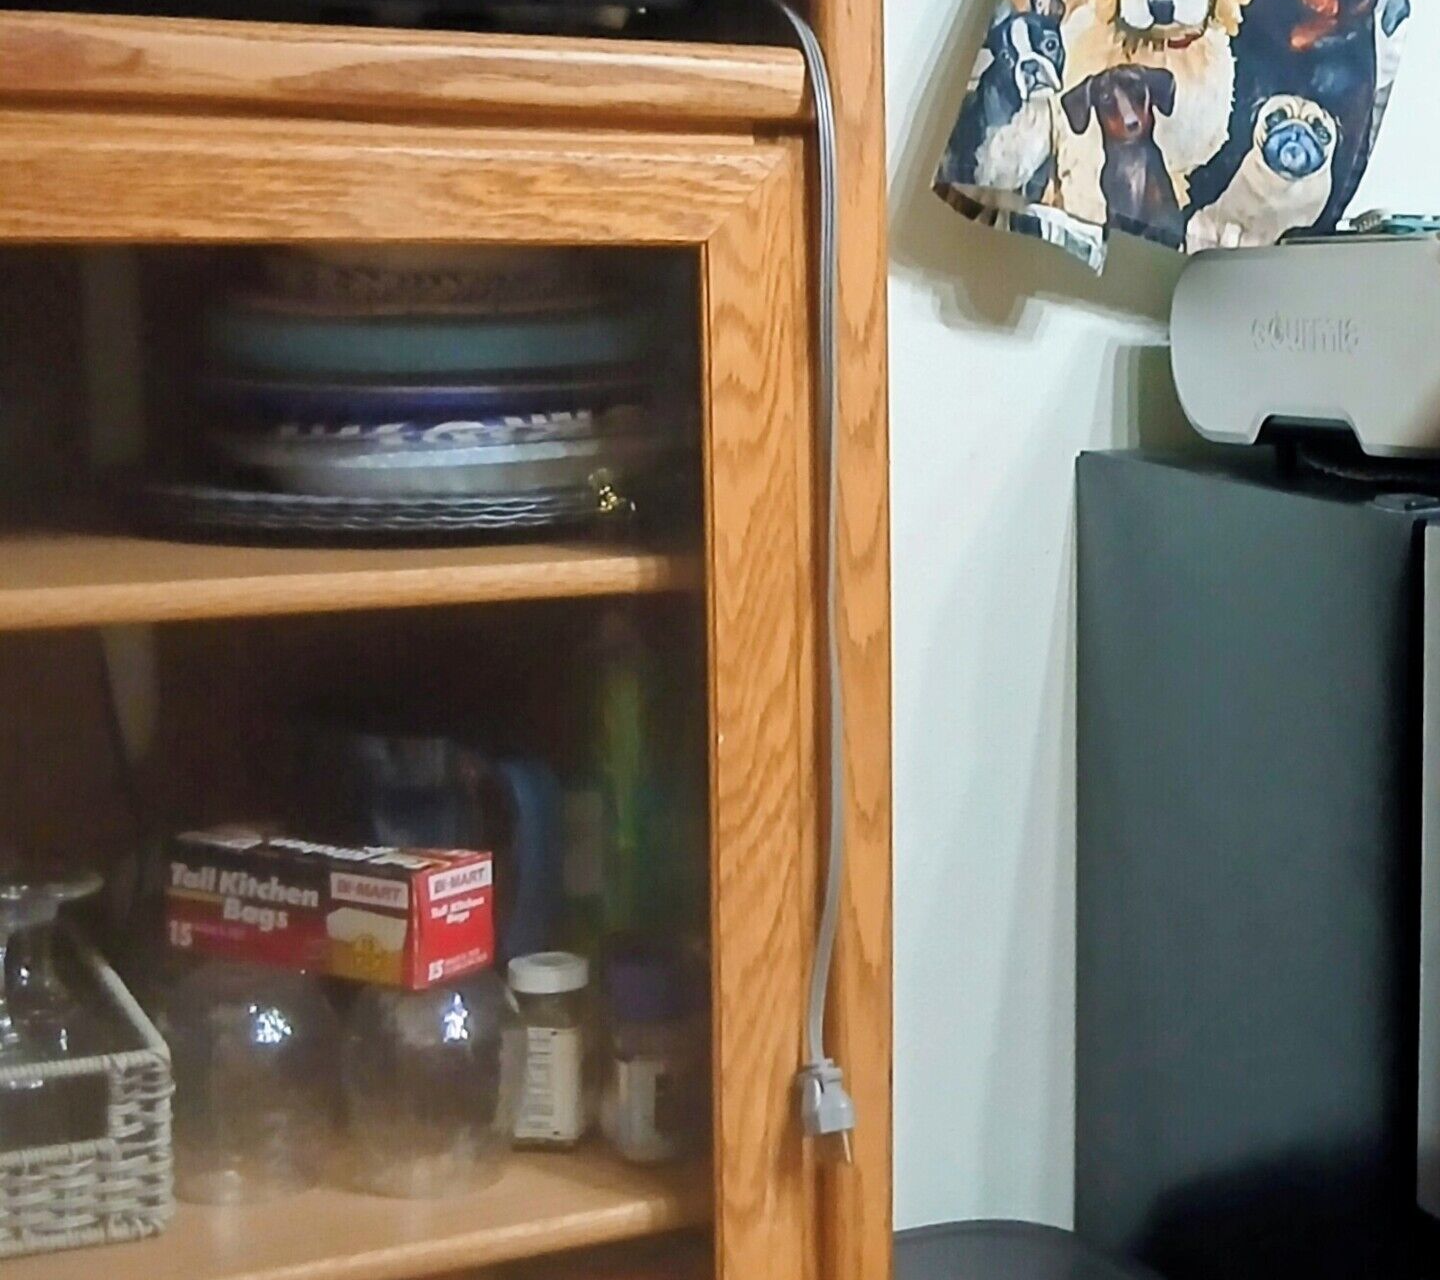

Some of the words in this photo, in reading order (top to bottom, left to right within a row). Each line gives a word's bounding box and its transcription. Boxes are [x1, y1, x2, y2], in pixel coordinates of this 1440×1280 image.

[170, 861, 217, 892] Tall
[218, 870, 319, 908] Kitchen
[433, 867, 487, 895] BI-MART
[222, 896, 288, 933] Bags
